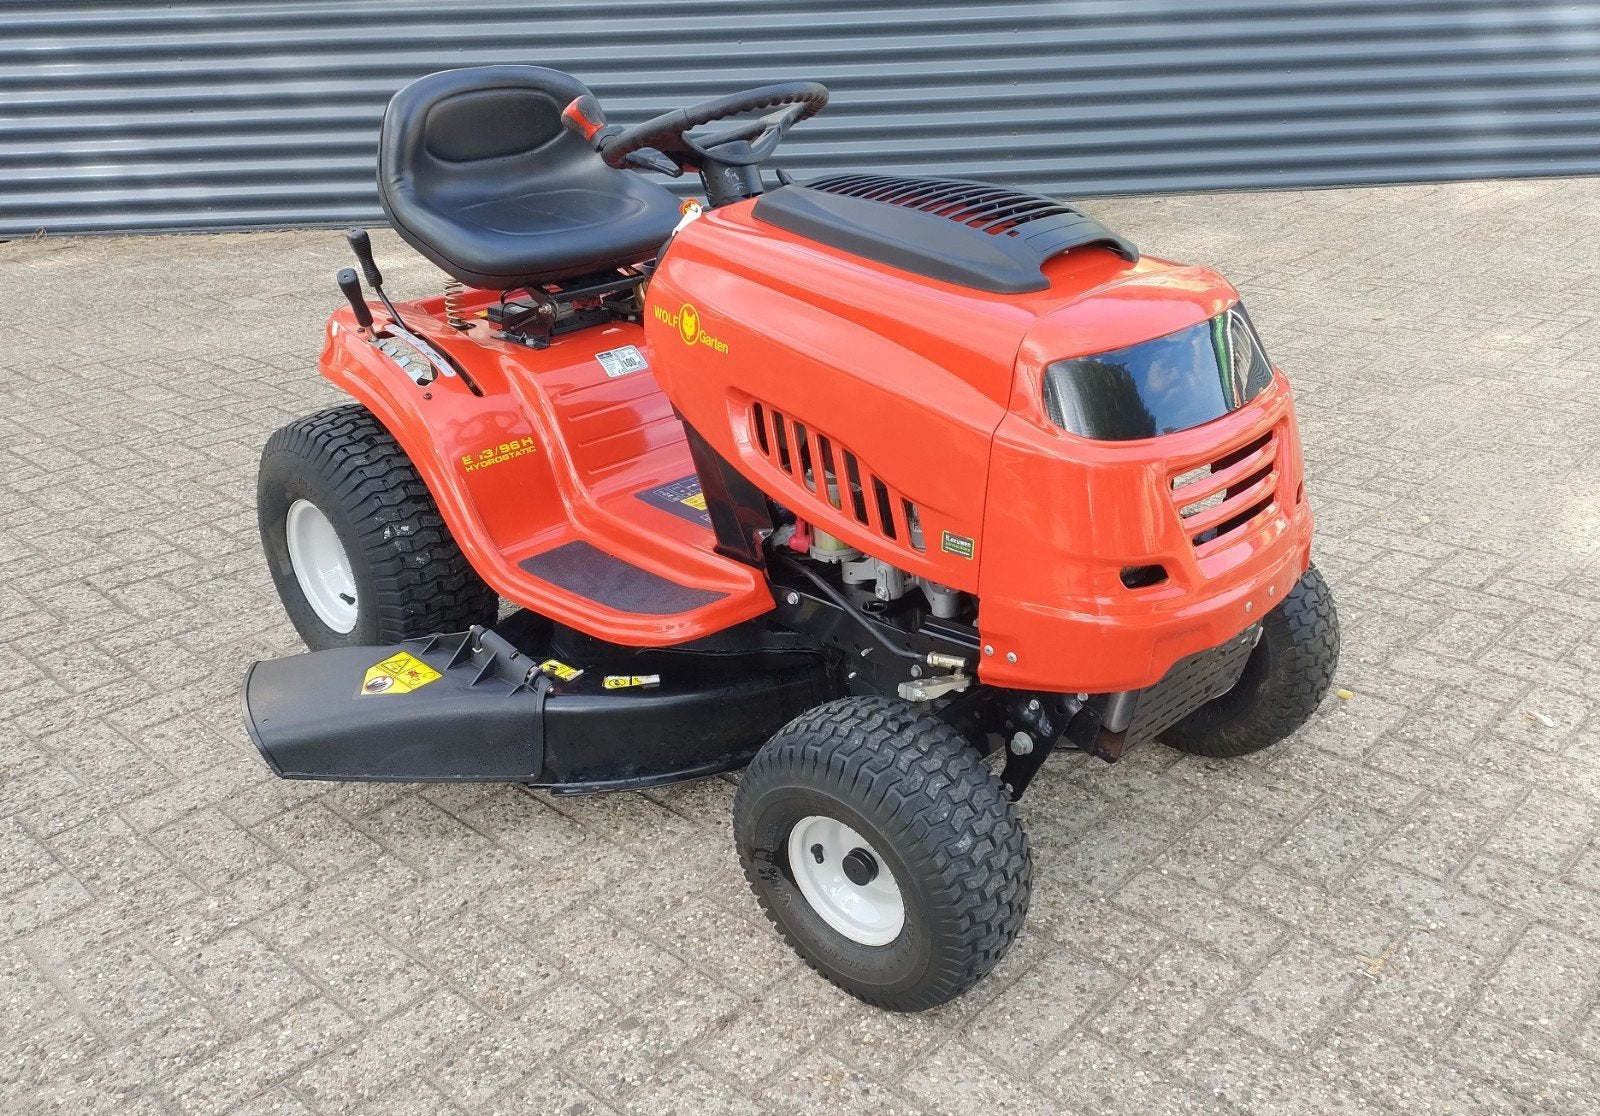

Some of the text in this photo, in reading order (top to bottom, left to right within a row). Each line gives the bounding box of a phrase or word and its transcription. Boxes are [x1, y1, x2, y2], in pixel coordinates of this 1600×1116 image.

[654, 304, 729, 354] WOLF Garten
[622, 357, 637, 368] 100
[521, 436, 534, 447] H
[464, 445, 537, 473] HYDROSTATIC
